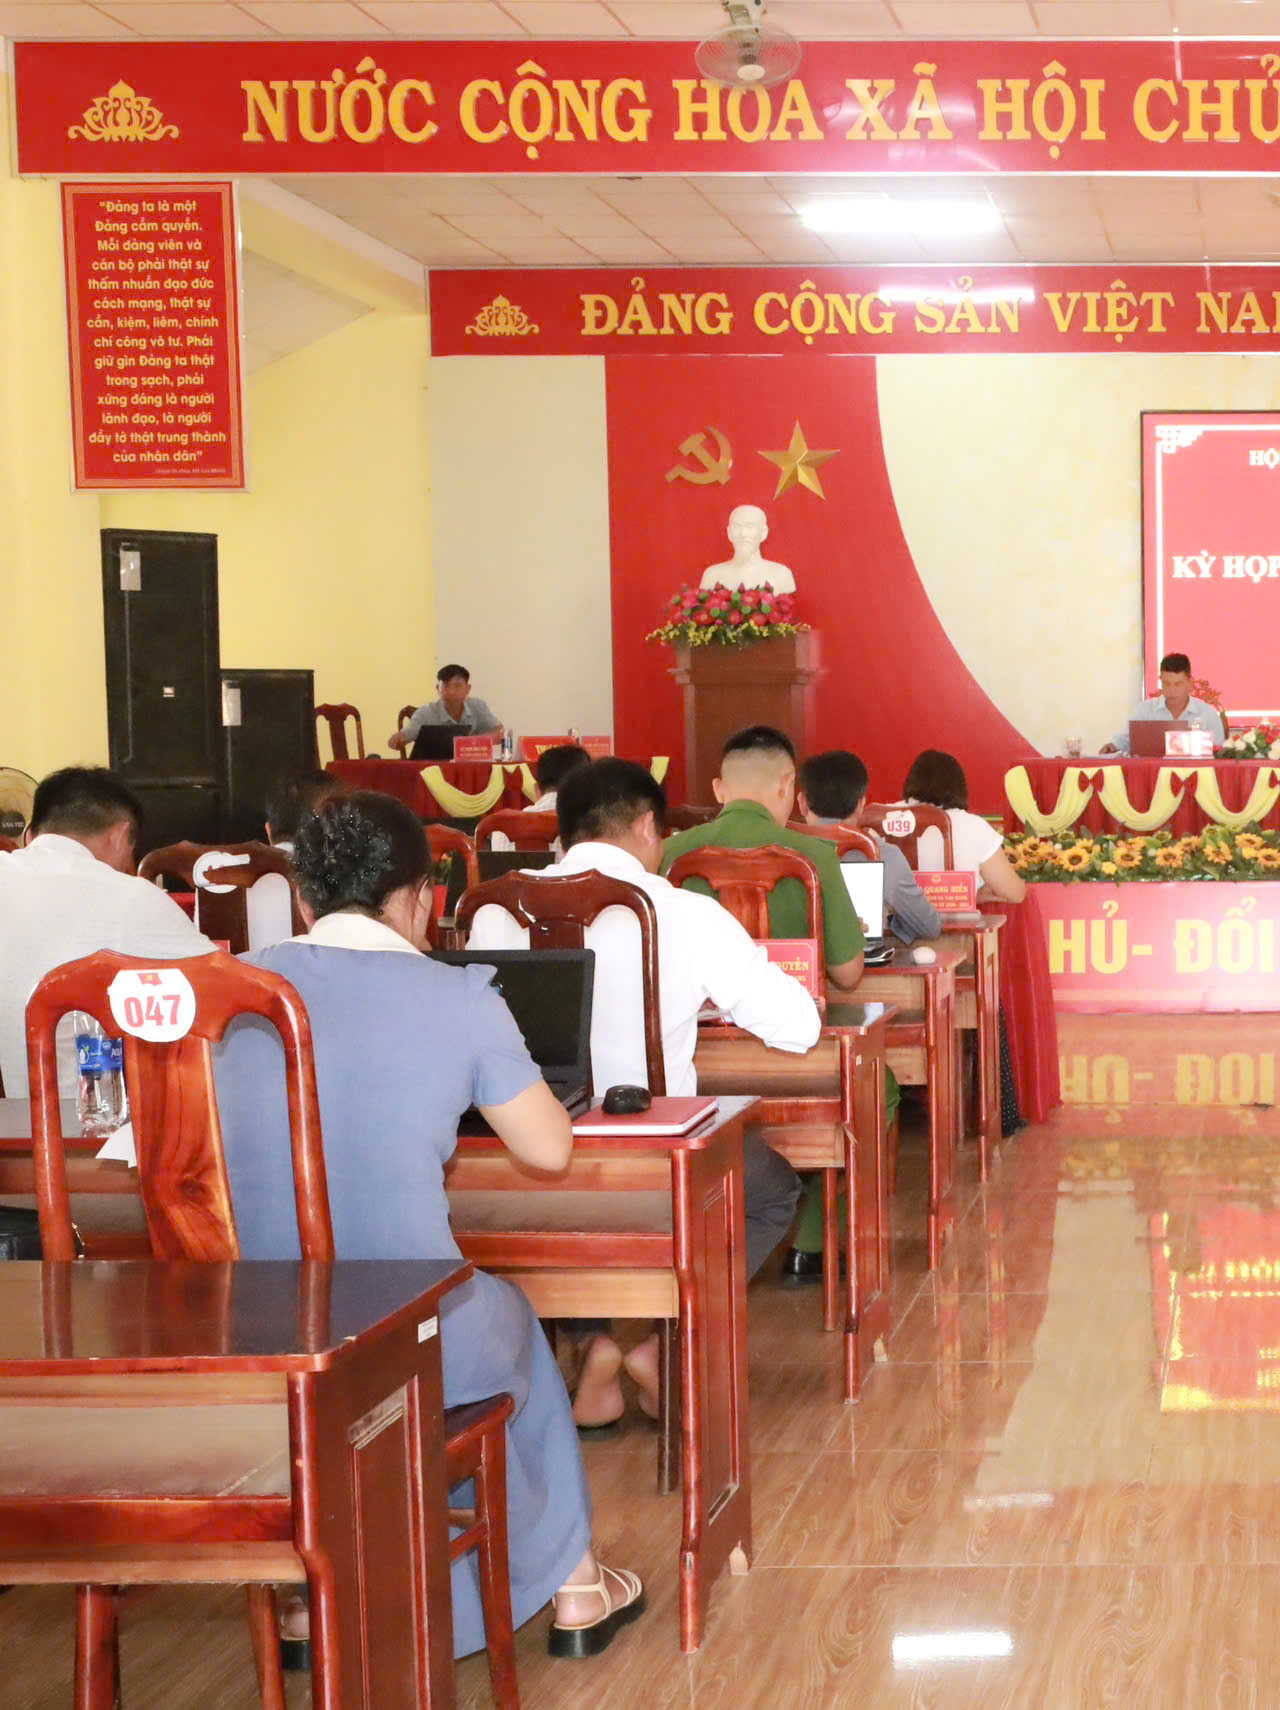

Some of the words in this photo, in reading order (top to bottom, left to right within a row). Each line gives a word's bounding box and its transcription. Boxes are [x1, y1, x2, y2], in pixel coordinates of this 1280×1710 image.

[241, 57, 438, 144] NƯỚC
[460, 59, 652, 160] CỘNG
[844, 62, 953, 142] XÃ
[978, 59, 1107, 159] HỘI
[142, 202, 154, 211] ta
[158, 201, 169, 211] là
[173, 201, 196, 214] một
[95, 219, 128, 234] Đảng
[123, 240, 154, 253] đảng
[158, 240, 183, 250] viên
[187, 240, 201, 250] và
[92, 260, 114, 270] cán
[119, 259, 134, 273] bộ
[138, 259, 164, 272] phải
[168, 260, 192, 273] thật
[196, 260, 209, 273] sự
[164, 279, 187, 292] đạo
[191, 277, 214, 288] đức
[94, 297, 124, 309] cách
[128, 300, 166, 311] mạng,
[170, 296, 194, 311] thật
[197, 298, 211, 311] sự
[581, 277, 733, 337] ĐẢNG
[754, 280, 896, 345] CỘNG
[914, 276, 1020, 334] SẢN
[1045, 279, 1175, 343] VIỆT
[117, 316, 150, 331] kiệm,
[153, 317, 182, 329] liêm,
[186, 315, 218, 328] chính
[94, 336, 112, 347] chí
[116, 338, 146, 350] công
[150, 337, 164, 347] vô
[168, 336, 182, 347] tư.
[187, 335, 212, 347] Phải
[95, 355, 114, 369] giữ
[117, 355, 135, 369] gìn
[139, 354, 171, 369] Đảng
[175, 355, 187, 366] ta
[191, 354, 214, 369] thật
[106, 375, 137, 388] trong
[141, 374, 173, 388] sạch,
[177, 373, 204, 387] phải
[98, 394, 127, 407] xứng
[131, 393, 162, 407] đáng
[166, 393, 177, 404] là
[181, 393, 214, 407] người
[132, 413, 159, 426] đạo,
[163, 412, 174, 424] là
[178, 412, 212, 426] người
[130, 432, 154, 446] thật
[157, 432, 188, 445] trung
[192, 432, 226, 442] thành
[113, 451, 136, 462] của
[140, 451, 169, 462] nhân
[1172, 551, 1219, 579] KỲ
[1049, 900, 1152, 974] HỦ-
[1174, 896, 1275, 974] ĐỔI
[124, 995, 181, 1027] 047
